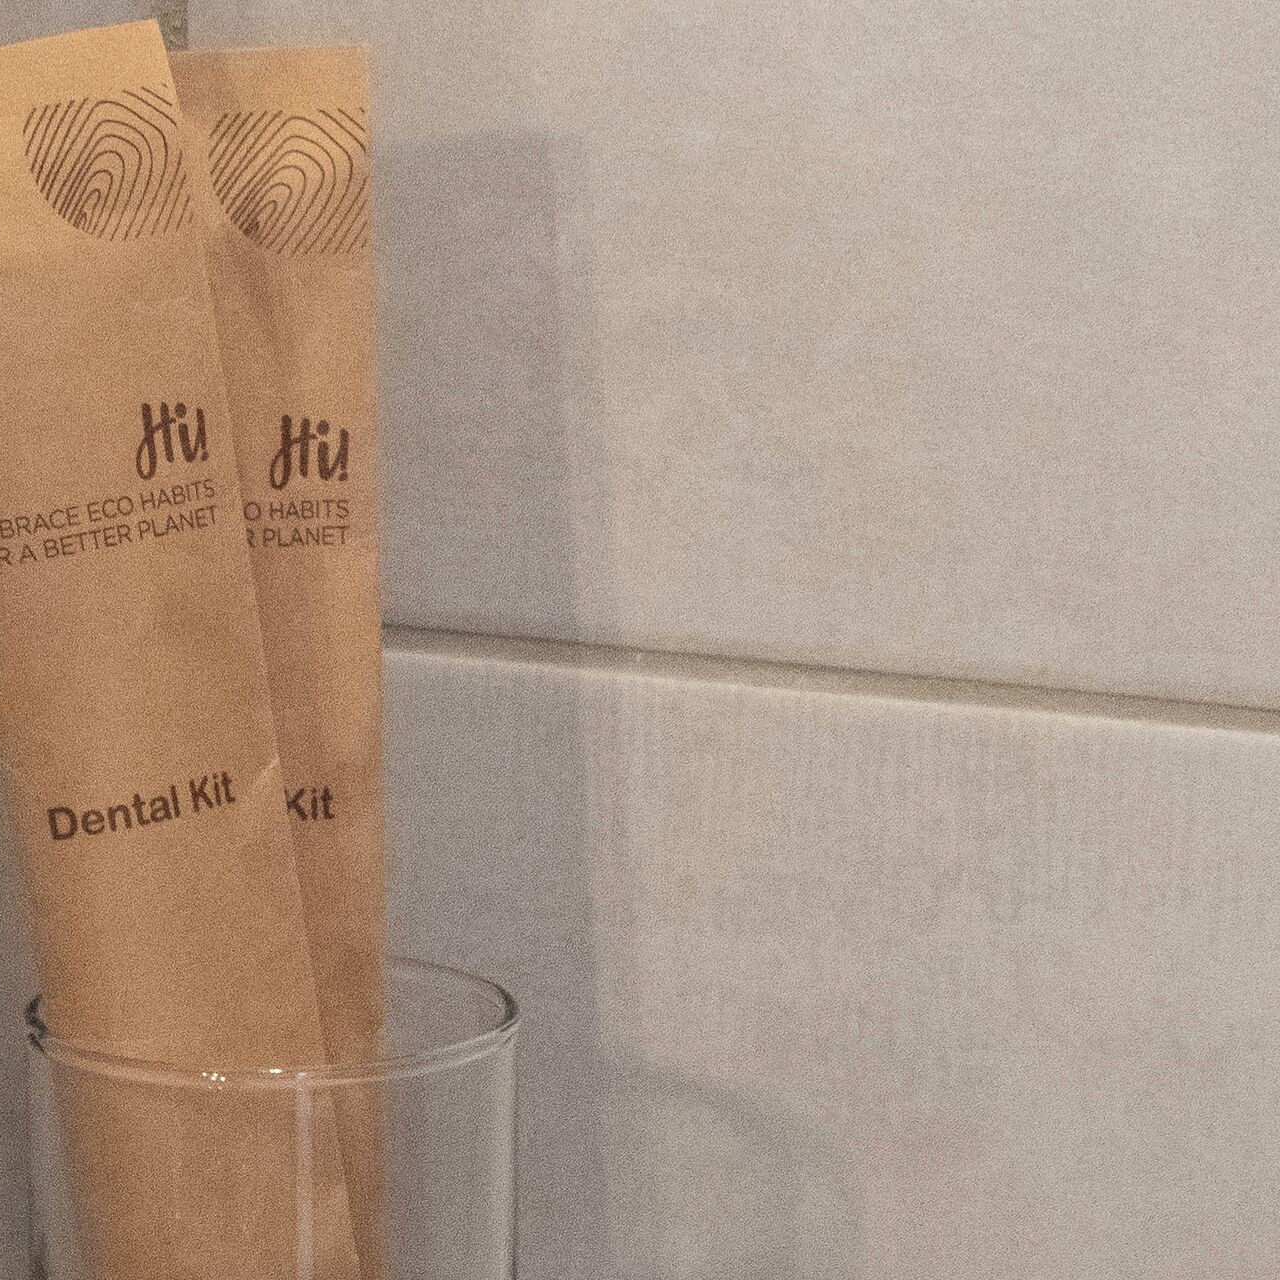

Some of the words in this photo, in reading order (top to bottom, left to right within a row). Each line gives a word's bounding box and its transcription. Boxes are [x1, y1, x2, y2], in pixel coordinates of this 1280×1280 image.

[135, 401, 209, 481] Hi!
[270, 414, 350, 491] Hi!
[87, 495, 134, 523] ECO
[139, 478, 215, 511] HABITS
[270, 499, 350, 520] HABITS
[19, 543, 38, 565] A
[42, 523, 133, 559] BETTER
[138, 505, 218, 540] PLANET
[262, 524, 350, 548] PLANET
[46, 784, 182, 841] Dental
[188, 770, 238, 814] Kit
[283, 785, 336, 820] Kit
